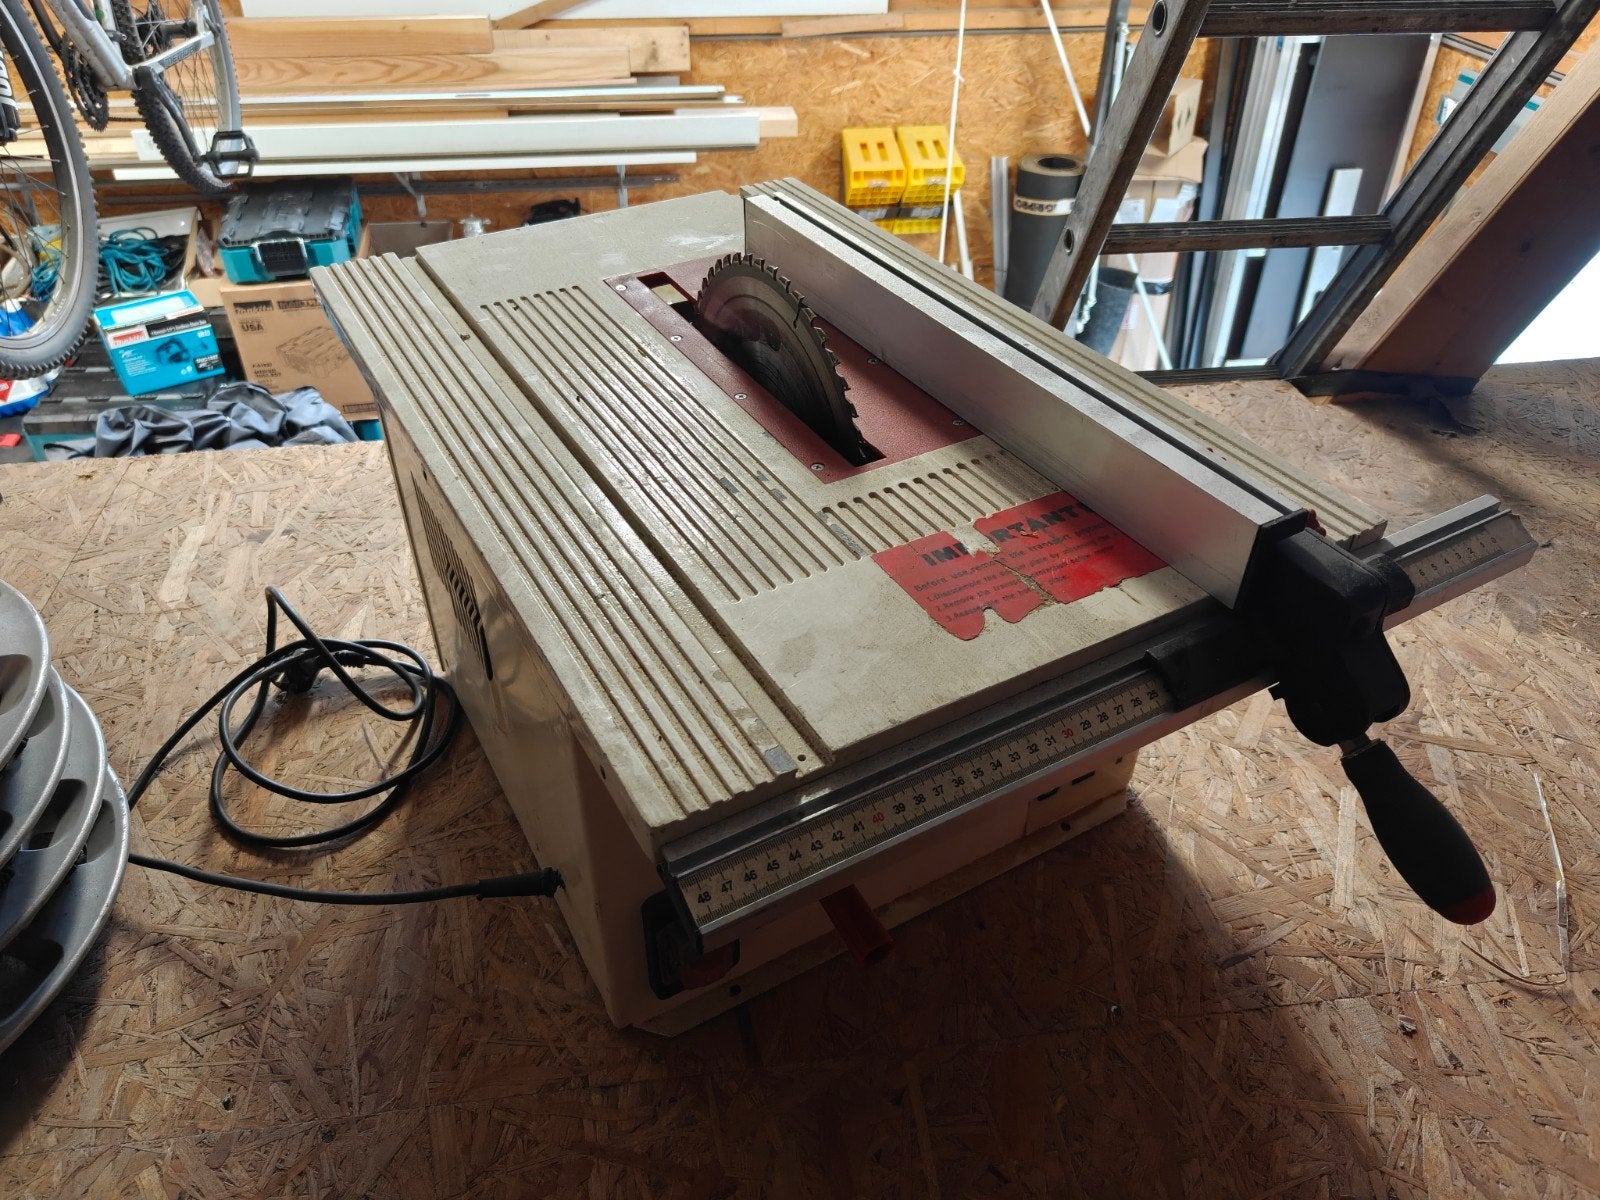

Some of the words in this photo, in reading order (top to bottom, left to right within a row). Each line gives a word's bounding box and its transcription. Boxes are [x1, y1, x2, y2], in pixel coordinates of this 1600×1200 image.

[240, 324, 264, 332] USA
[696, 890, 712, 905] 48
[721, 880, 734, 894] 47
[743, 870, 758, 883] 46
[766, 859, 781, 873] 45
[788, 849, 803, 863] 44
[810, 839, 824, 853] 43
[831, 830, 846, 843] 42
[852, 821, 866, 833] 41
[871, 811, 885, 824] 40
[892, 802, 906, 815] 39
[914, 792, 927, 806] 38
[932, 784, 945, 798] 37
[952, 774, 966, 789] 36
[970, 766, 985, 780] 35
[989, 758, 1003, 772] 34
[1008, 750, 1021, 764] 33
[1026, 741, 1040, 756] 32
[1044, 734, 1057, 748] 31
[1061, 726, 1075, 739] 30
[1079, 718, 1093, 732] 29
[1096, 710, 1110, 724] 28
[1113, 703, 1126, 716] 27
[1130, 696, 1143, 709] 26
